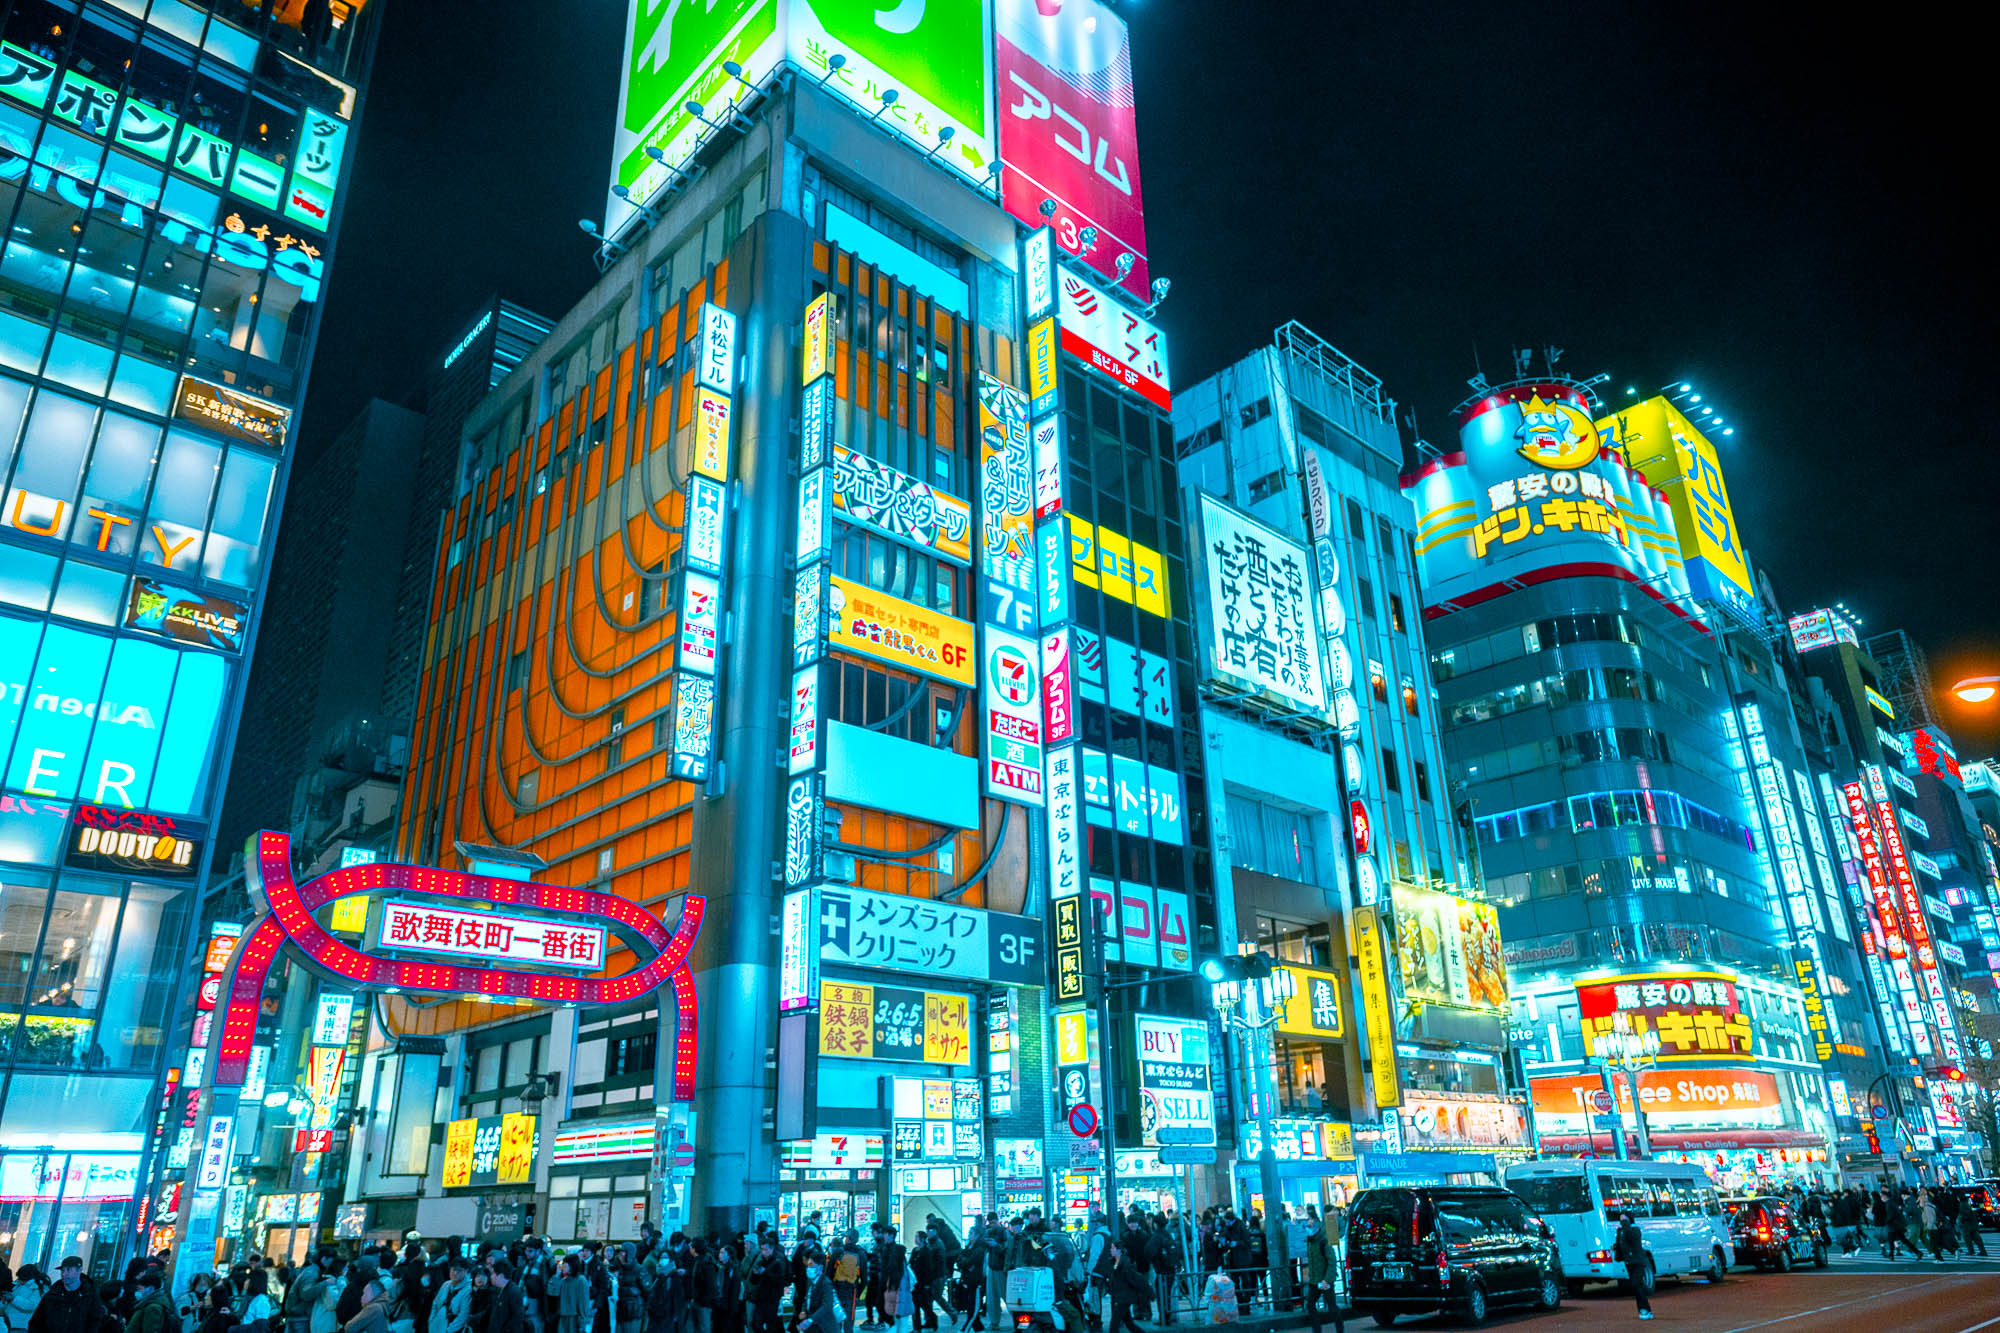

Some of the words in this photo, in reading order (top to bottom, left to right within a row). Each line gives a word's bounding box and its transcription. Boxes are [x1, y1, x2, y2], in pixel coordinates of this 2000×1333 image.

[305, 119, 339, 175] ダーツ
[1009, 69, 1133, 196] アコム
[708, 313, 728, 384] 小松ビル
[1036, 327, 1050, 391] プロミス
[1092, 349, 1121, 375] 当ビル
[1124, 365, 1139, 386] 5F
[186, 391, 207, 408] SK
[1038, 395, 1053, 411] 6F
[809, 420, 821, 463] STAND
[1044, 535, 1060, 612] セントラル
[1071, 533, 1158, 595] プロミス
[988, 582, 1033, 631] 7F
[1213, 540, 1247, 669] だけの店
[1270, 560, 1296, 687] こだわりの
[796, 644, 816, 664] 7F
[941, 642, 967, 668] 6F
[1048, 673, 1064, 724] アコム
[993, 712, 1037, 743] たばこ
[679, 756, 705, 777] 7F
[1005, 740, 1026, 764] 酒
[994, 762, 1039, 791] ATM
[1084, 774, 1179, 823] セントラル
[1053, 758, 1074, 887] 東京ぶらんど
[1127, 818, 1139, 832] 4F
[1880, 801, 1904, 868] KARAOKE
[78, 826, 194, 865] DOUTOR
[1766, 799, 1798, 889] KIBORI
[1632, 877, 1651, 889] LIVE
[1655, 877, 1677, 889] HOUSE
[1899, 869, 1909, 880] &
[856, 899, 977, 937] メンズライフ
[1060, 903, 1075, 940] 買取
[1902, 884, 1923, 932] PARTY
[391, 911, 595, 961] 歌舞伎町一番街
[856, 931, 956, 969] クリニック
[999, 934, 1035, 965] 3F
[1062, 954, 1079, 993] 販売
[832, 987, 864, 1003] 名物
[939, 1000, 968, 1027] ビール
[1313, 980, 1337, 1027] 集
[1614, 982, 1731, 1009] 驚安の殿堂
[1899, 970, 1927, 1044] パセラ
[824, 1003, 869, 1027] 鉄鍋
[1927, 973, 1958, 1057] PASELA
[824, 1027, 869, 1053] 餃子
[885, 1028, 913, 1047] 酒場
[939, 1033, 968, 1060] サワー
[1143, 1030, 1179, 1054] BUY
[1163, 1096, 1209, 1121] SELL
[1678, 1080, 1730, 1106] Shop
[1369, 1158, 1408, 1170] SUBNADE
[1683, 1141, 1703, 1150] Don
[1704, 1141, 1738, 1150] Quijote
[492, 1213, 518, 1225] ZONE
